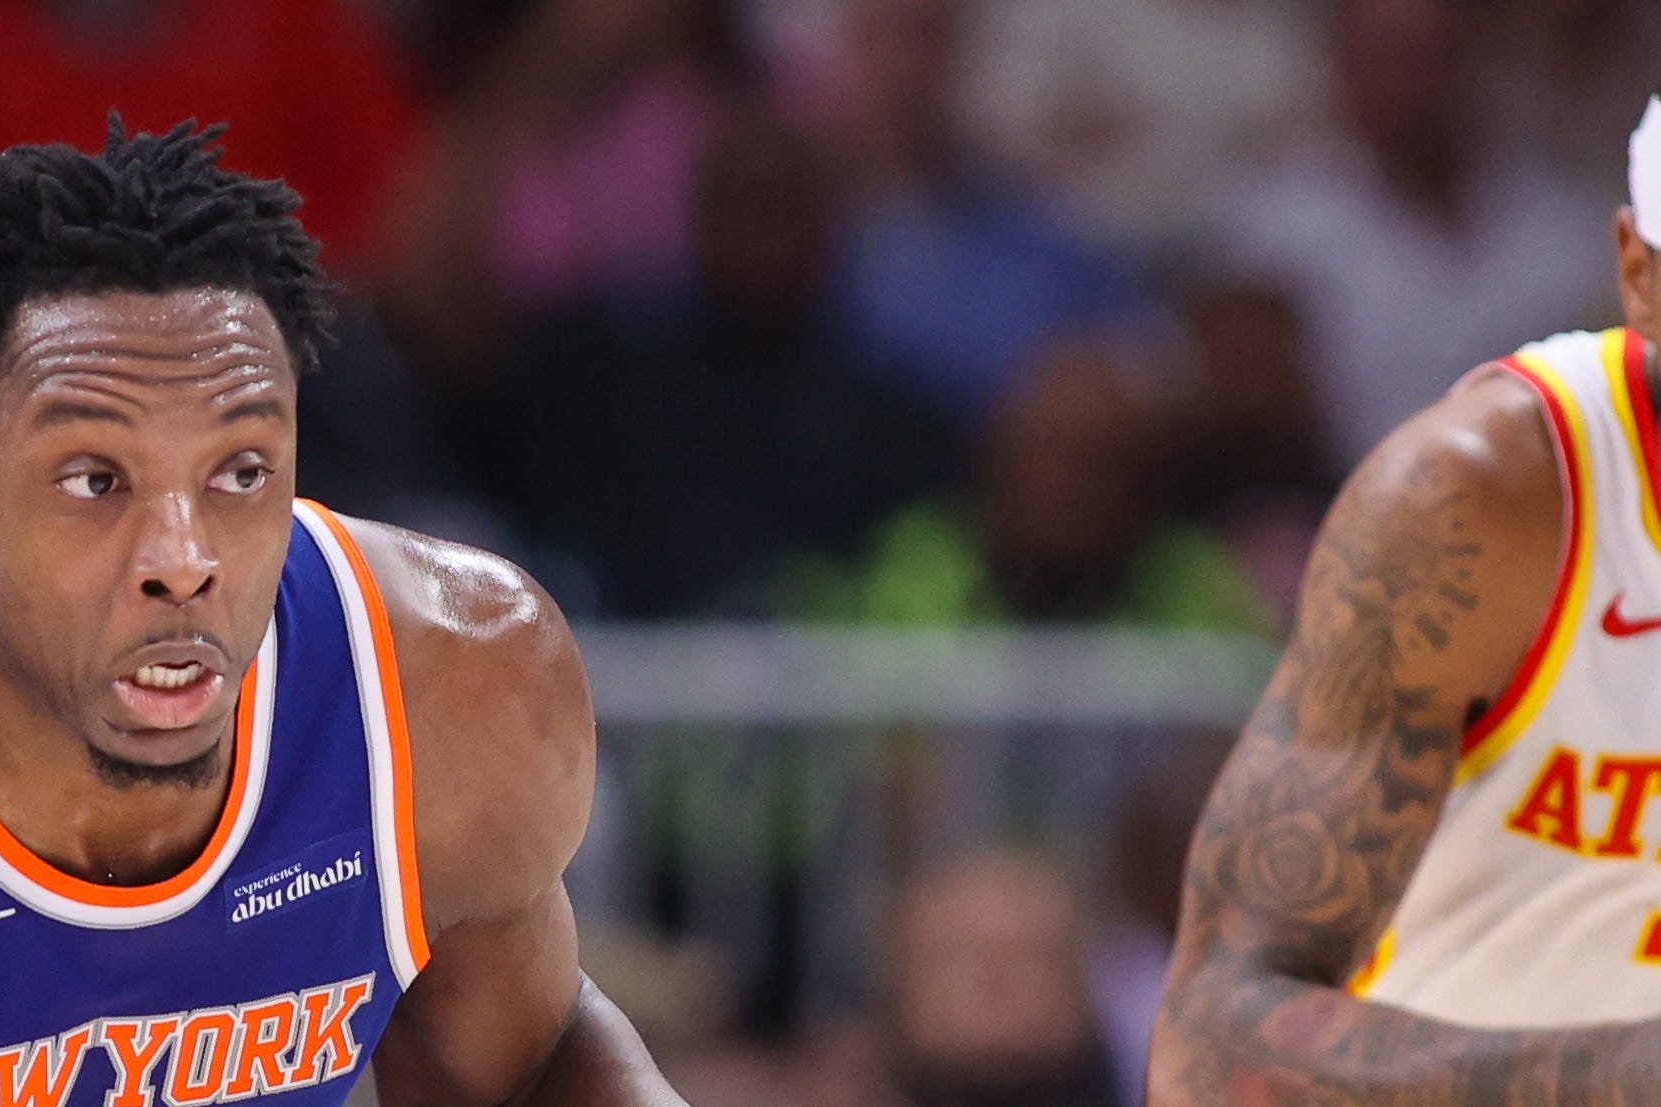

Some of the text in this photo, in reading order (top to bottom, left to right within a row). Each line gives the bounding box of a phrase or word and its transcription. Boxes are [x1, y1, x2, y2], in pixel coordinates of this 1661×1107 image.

[1505, 744, 1661, 862] AT
[233, 862, 302, 897] experience
[231, 888, 283, 923] abu
